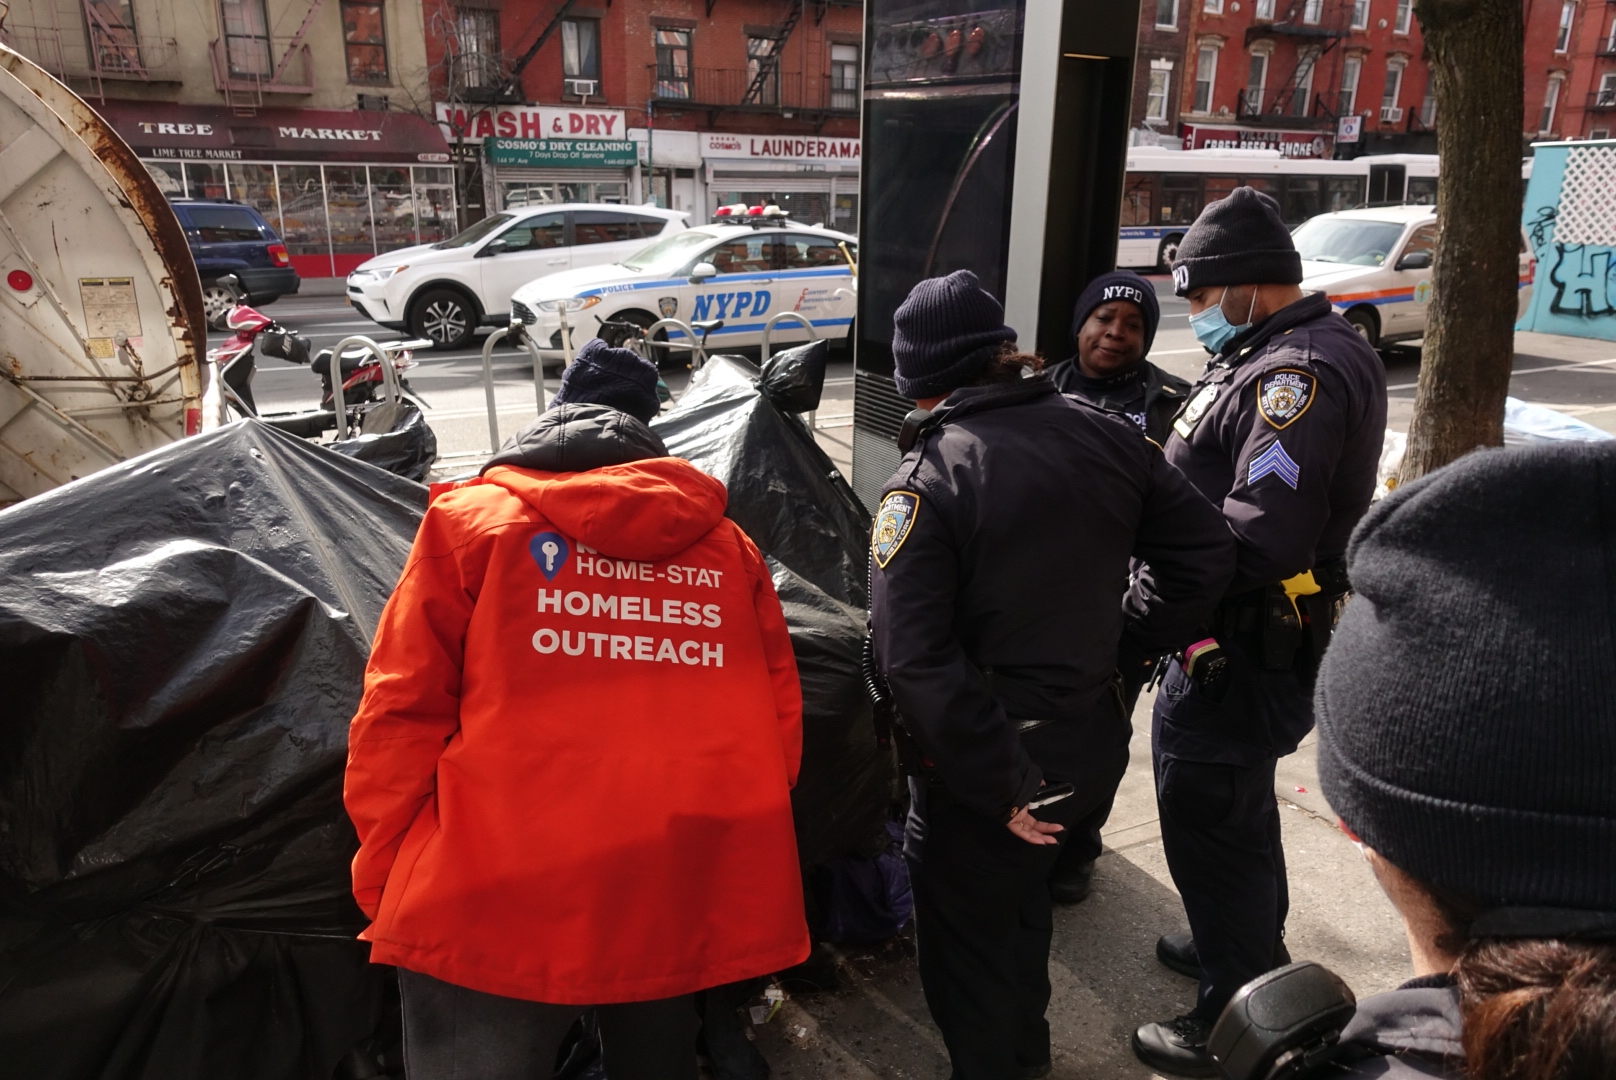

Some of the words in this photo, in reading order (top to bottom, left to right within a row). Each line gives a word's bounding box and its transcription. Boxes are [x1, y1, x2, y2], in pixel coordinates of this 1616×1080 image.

[138, 122, 213, 135] TREE
[278, 126, 382, 141] MARKET
[445, 109, 542, 139] WASH
[552, 117, 563, 133] &
[569, 113, 617, 135] DRY
[1239, 131, 1283, 141] VILLAGE
[152, 148, 176, 158] LIME
[178, 149, 203, 158] TREE
[205, 149, 242, 159] MARKET
[496, 140, 546, 150] COSMO'S
[549, 142, 573, 151] DRY
[575, 142, 633, 151] CLEANING
[709, 141, 741, 150] COSMO'S
[751, 139, 860, 158] LAUNDERAMA
[1279, 142, 1312, 156] SMOKE
[535, 151, 551, 159] Days
[552, 151, 568, 159] Drop
[602, 284, 634, 293] POLICE
[1103, 286, 1142, 303] NYPD
[691, 290, 772, 322] NYPD
[1264, 380, 1308, 391] DEPARTMENT
[1275, 373, 1300, 381] POLICE
[1285, 407, 1297, 419] NEW
[1295, 393, 1308, 408] YORK
[897, 519, 911, 540] YORK
[576, 556, 723, 588] HOME-STAT
[537, 588, 722, 628] HOMELESS
[532, 628, 724, 668] OUTREACH
